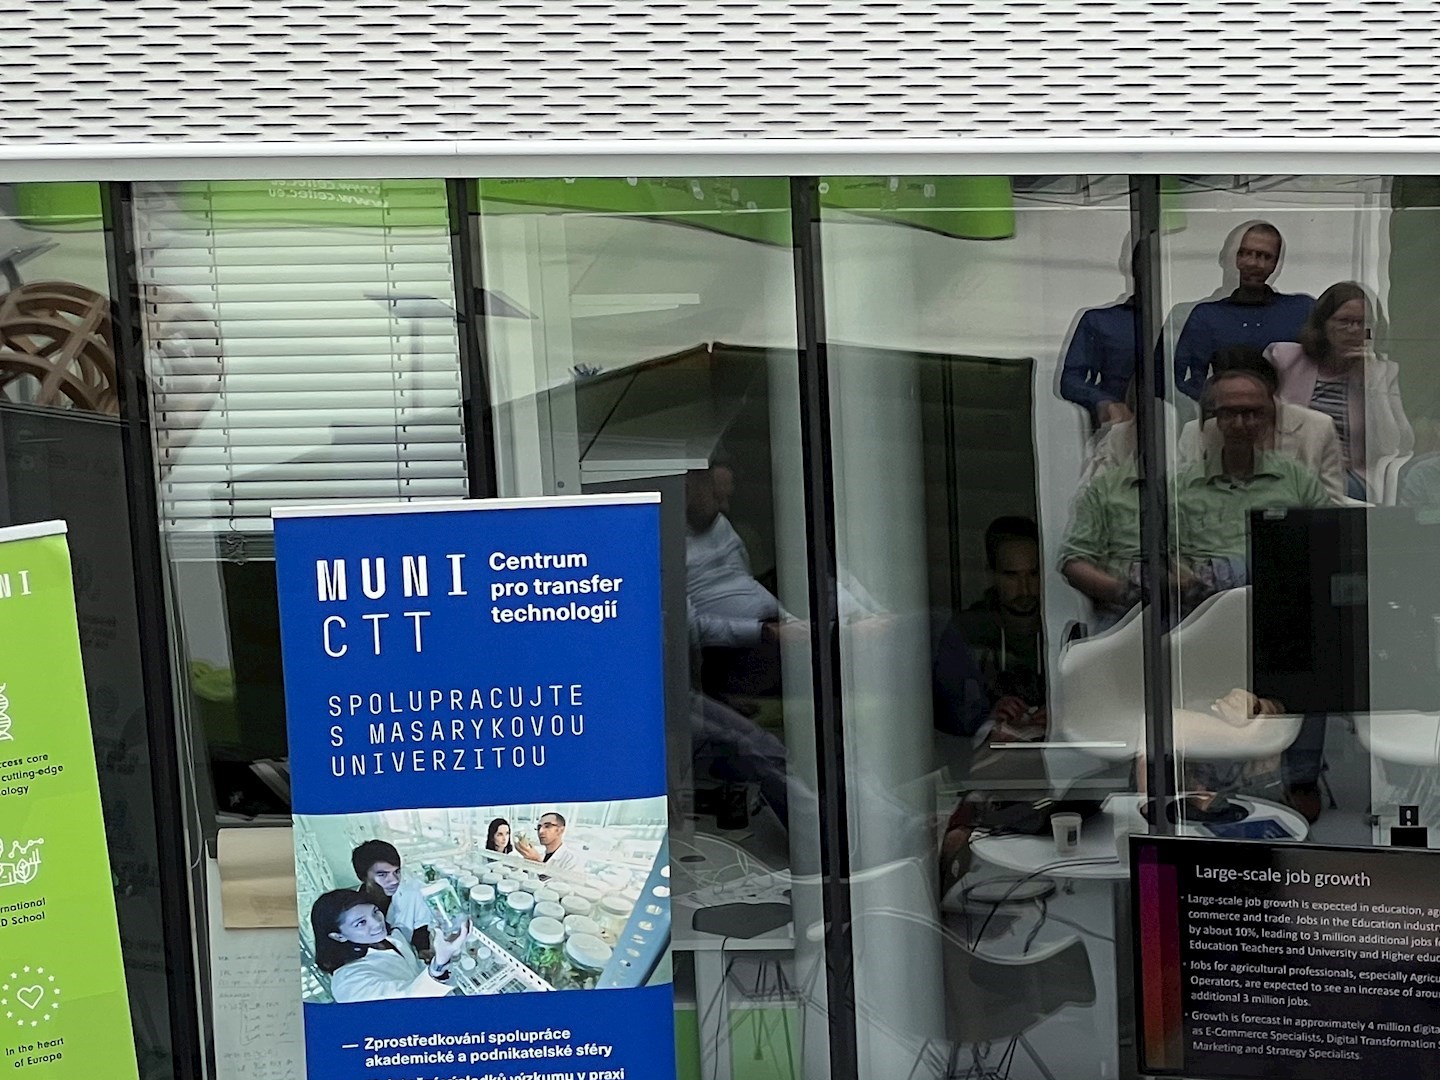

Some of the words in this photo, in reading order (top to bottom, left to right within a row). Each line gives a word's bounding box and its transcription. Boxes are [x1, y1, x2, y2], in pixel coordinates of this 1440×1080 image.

[489, 551, 588, 571] Centrum
[316, 553, 468, 602] MUNI
[490, 581, 528, 602] pro
[533, 574, 624, 596] transfer
[491, 600, 618, 623] technologií
[323, 610, 431, 658] CTT
[328, 684, 583, 718] SPOLUPRACUJTE
[330, 725, 344, 748] S
[369, 714, 585, 745] MASARYKOVOU
[0, 758, 23, 769] cess
[27, 754, 48, 764] core
[331, 745, 546, 777] UNIVERZITOU
[2, 765, 64, 782] cutting-edge
[0, 785, 29, 796] ology
[1195, 864, 1281, 882] Large-scale
[1284, 868, 1310, 885] job
[1314, 872, 1370, 887] growth
[11, 911, 45, 925] School
[1189, 939, 1238, 951] Education
[1240, 942, 1283, 954] Teachers
[1285, 945, 1305, 955] and
[1307, 946, 1357, 959] University
[1359, 949, 1378, 959] and
[1381, 950, 1414, 962] Higher
[1190, 960, 1211, 970] Jobs
[1213, 960, 1228, 971] for
[1230, 963, 1286, 974] agricultural
[1358, 971, 1407, 983] especially
[1191, 1010, 1229, 1021] Growth
[1230, 1013, 1239, 1022] is
[1240, 1012, 1280, 1025] forecast
[1282, 1015, 1292, 1025] in
[1294, 1018, 1365, 1031] approximately
[1367, 1021, 1374, 1029] 4
[1376, 1021, 1410, 1032] million
[18, 1045, 34, 1053] the
[37, 1037, 64, 1049] heart
[364, 1031, 485, 1051] Zprostředkování
[488, 1027, 570, 1045] spolupráce
[1192, 1041, 1243, 1054] Marketing
[1244, 1044, 1263, 1054] and
[1265, 1045, 1307, 1058] Strategy
[14, 1058, 24, 1068] of
[27, 1052, 62, 1065] Europe
[365, 1050, 454, 1067] akademické
[457, 1052, 466, 1062] a
[469, 1044, 572, 1064] podnikatelské
[575, 1042, 612, 1057] sféry
[576, 1071, 585, 1080] v
